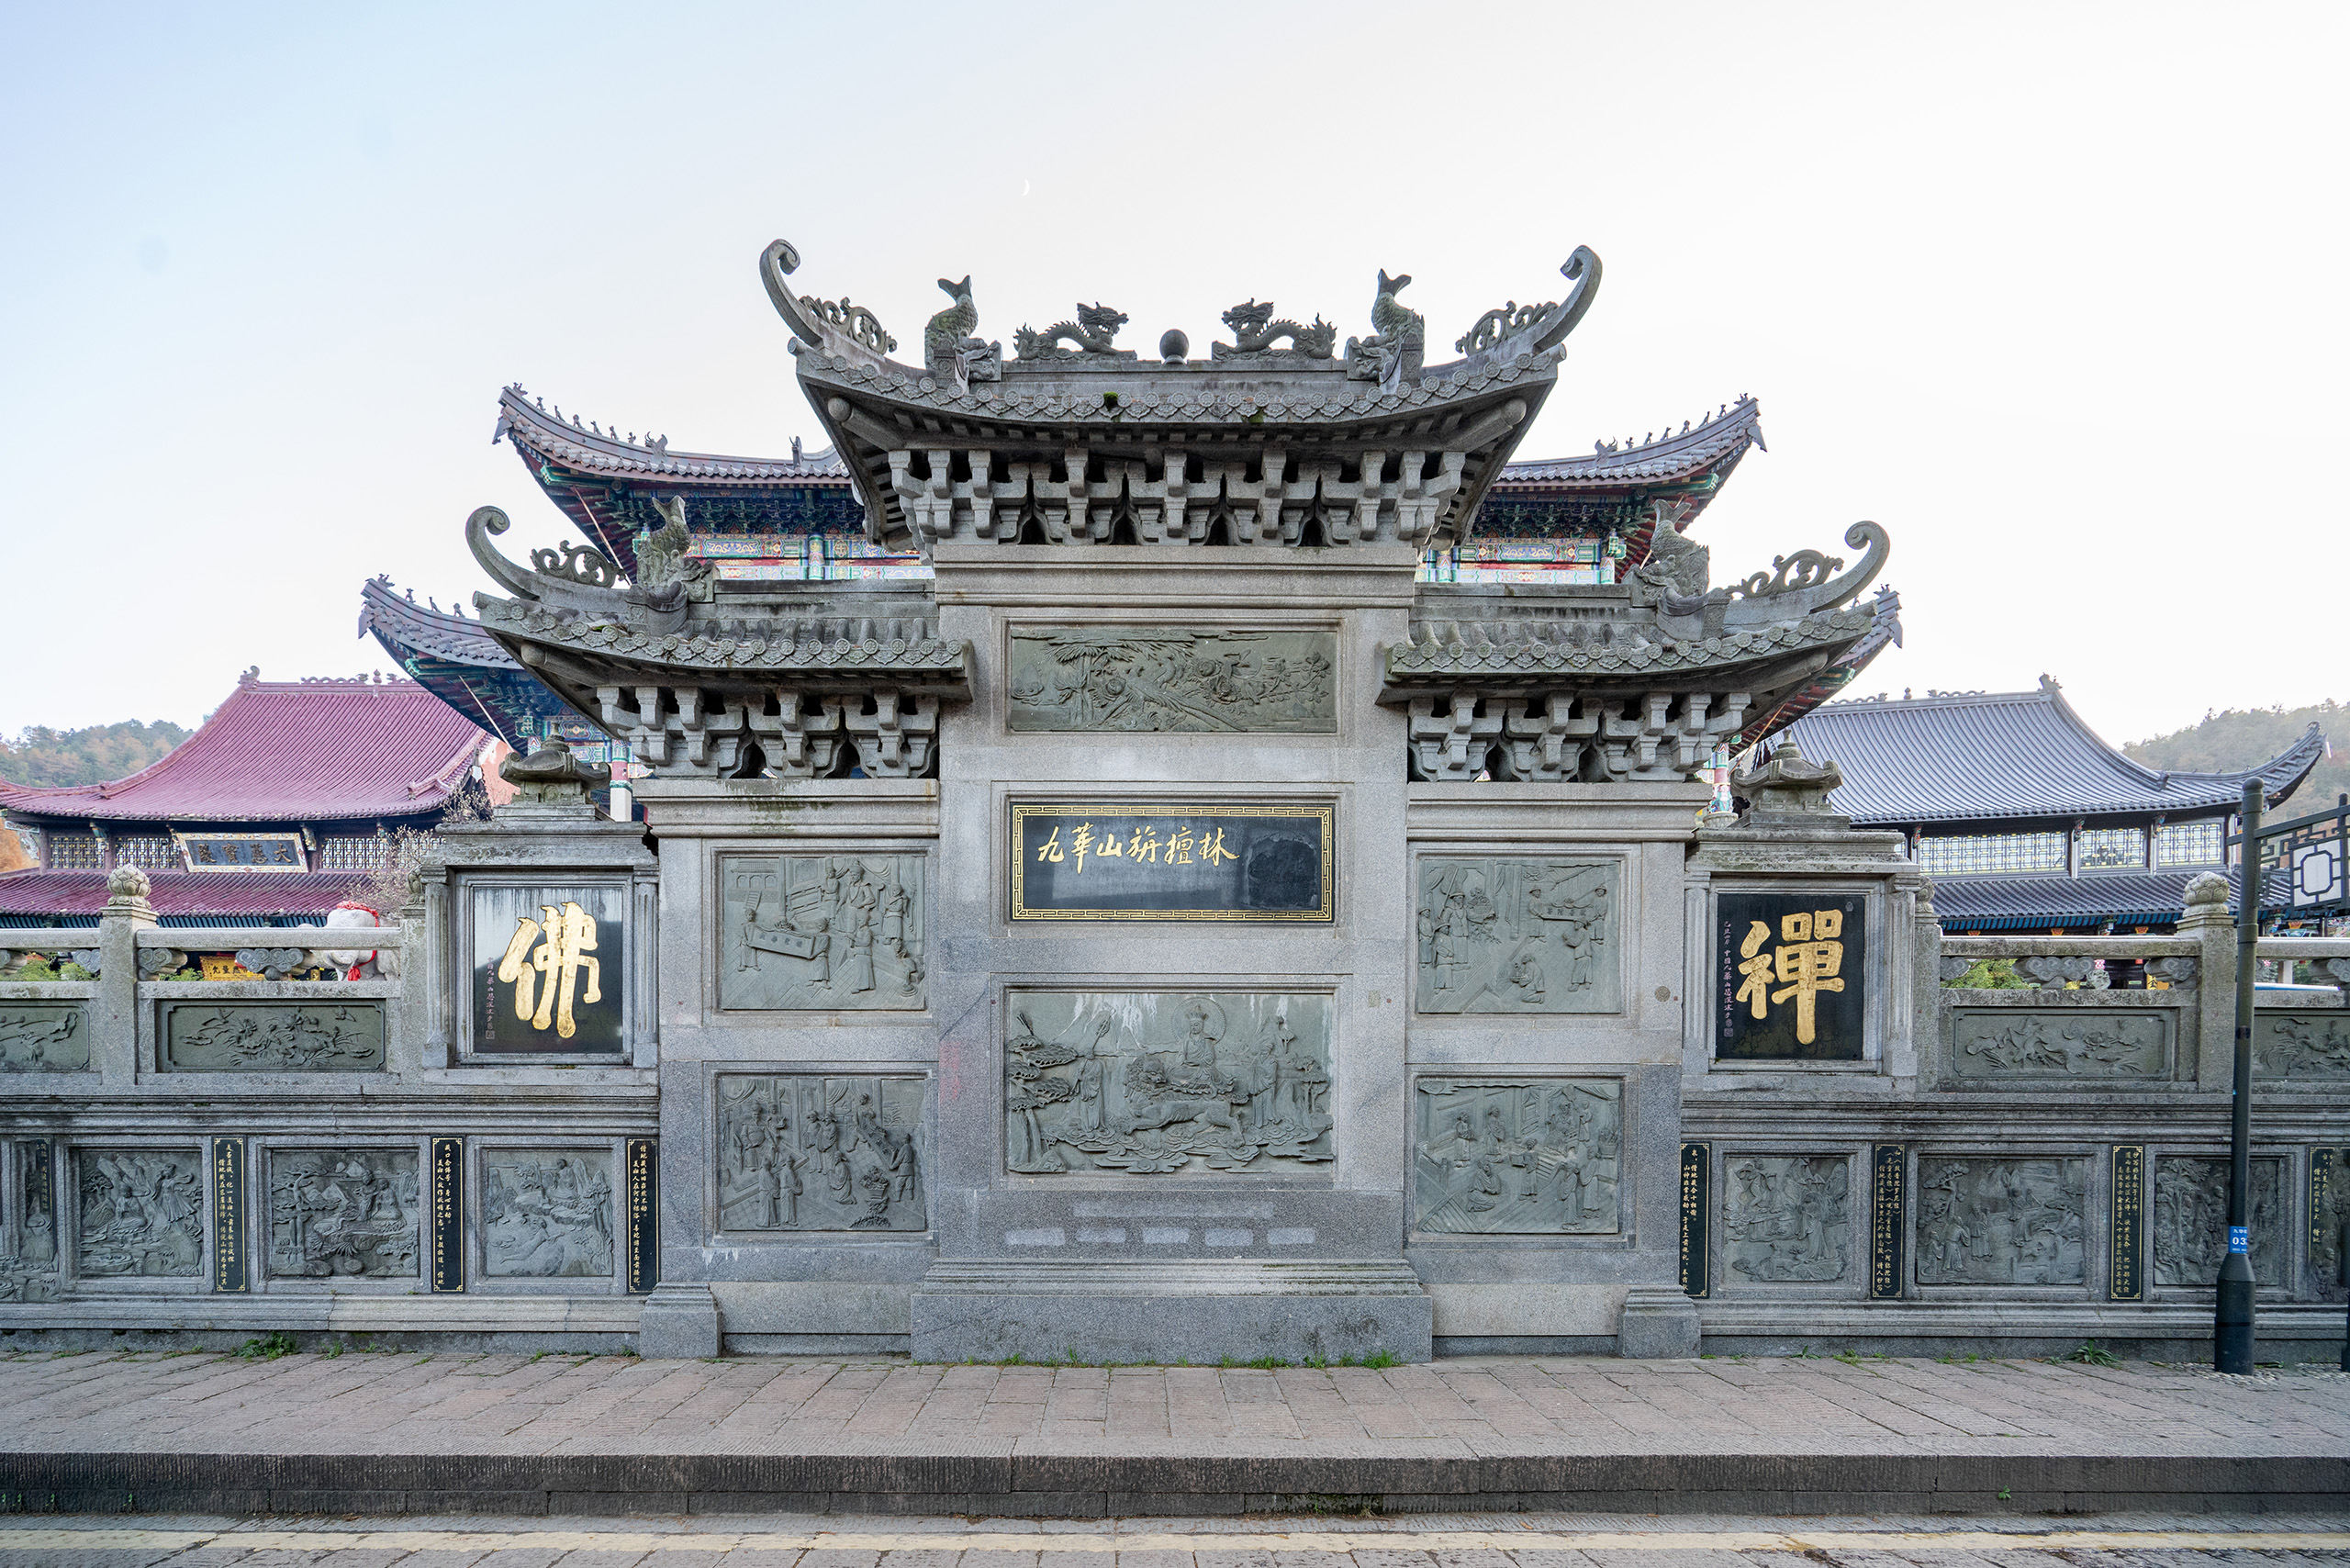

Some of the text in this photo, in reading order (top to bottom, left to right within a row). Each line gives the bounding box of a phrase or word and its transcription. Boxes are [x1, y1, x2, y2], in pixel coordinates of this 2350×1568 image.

[1037, 822, 1240, 875] 九華山旃檀林
[498, 902, 601, 1038] 佛
[1736, 909, 1845, 1045] 禪
[2232, 1237, 2247, 1246] 03
